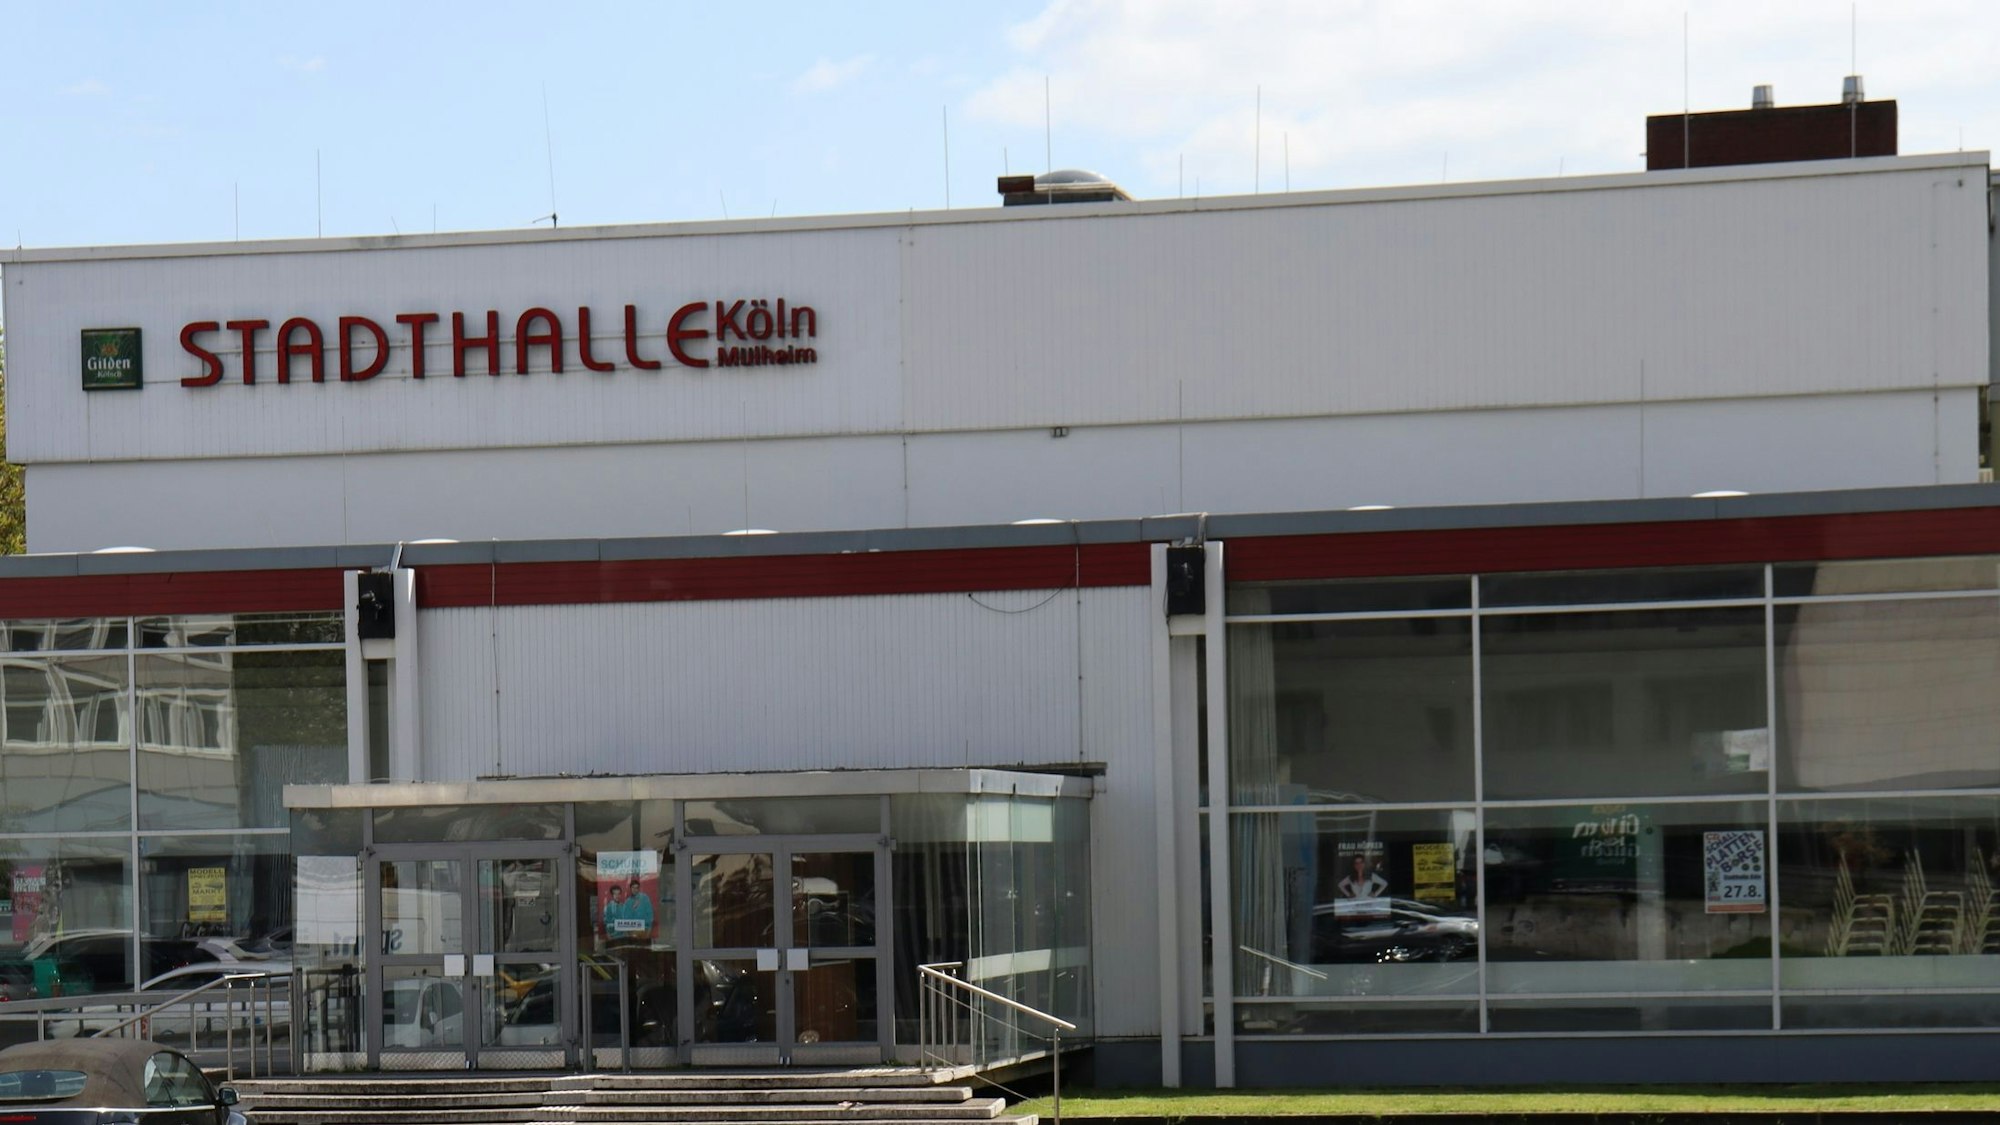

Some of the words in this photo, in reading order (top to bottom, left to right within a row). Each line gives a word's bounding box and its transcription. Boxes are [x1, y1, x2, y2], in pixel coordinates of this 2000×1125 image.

[716, 298, 816, 341] Köln
[180, 301, 709, 387] STADTHALLE
[87, 356, 130, 370] Gilden
[1707, 832, 1757, 869] PLATTEN
[1724, 884, 1762, 898] 27.8.
